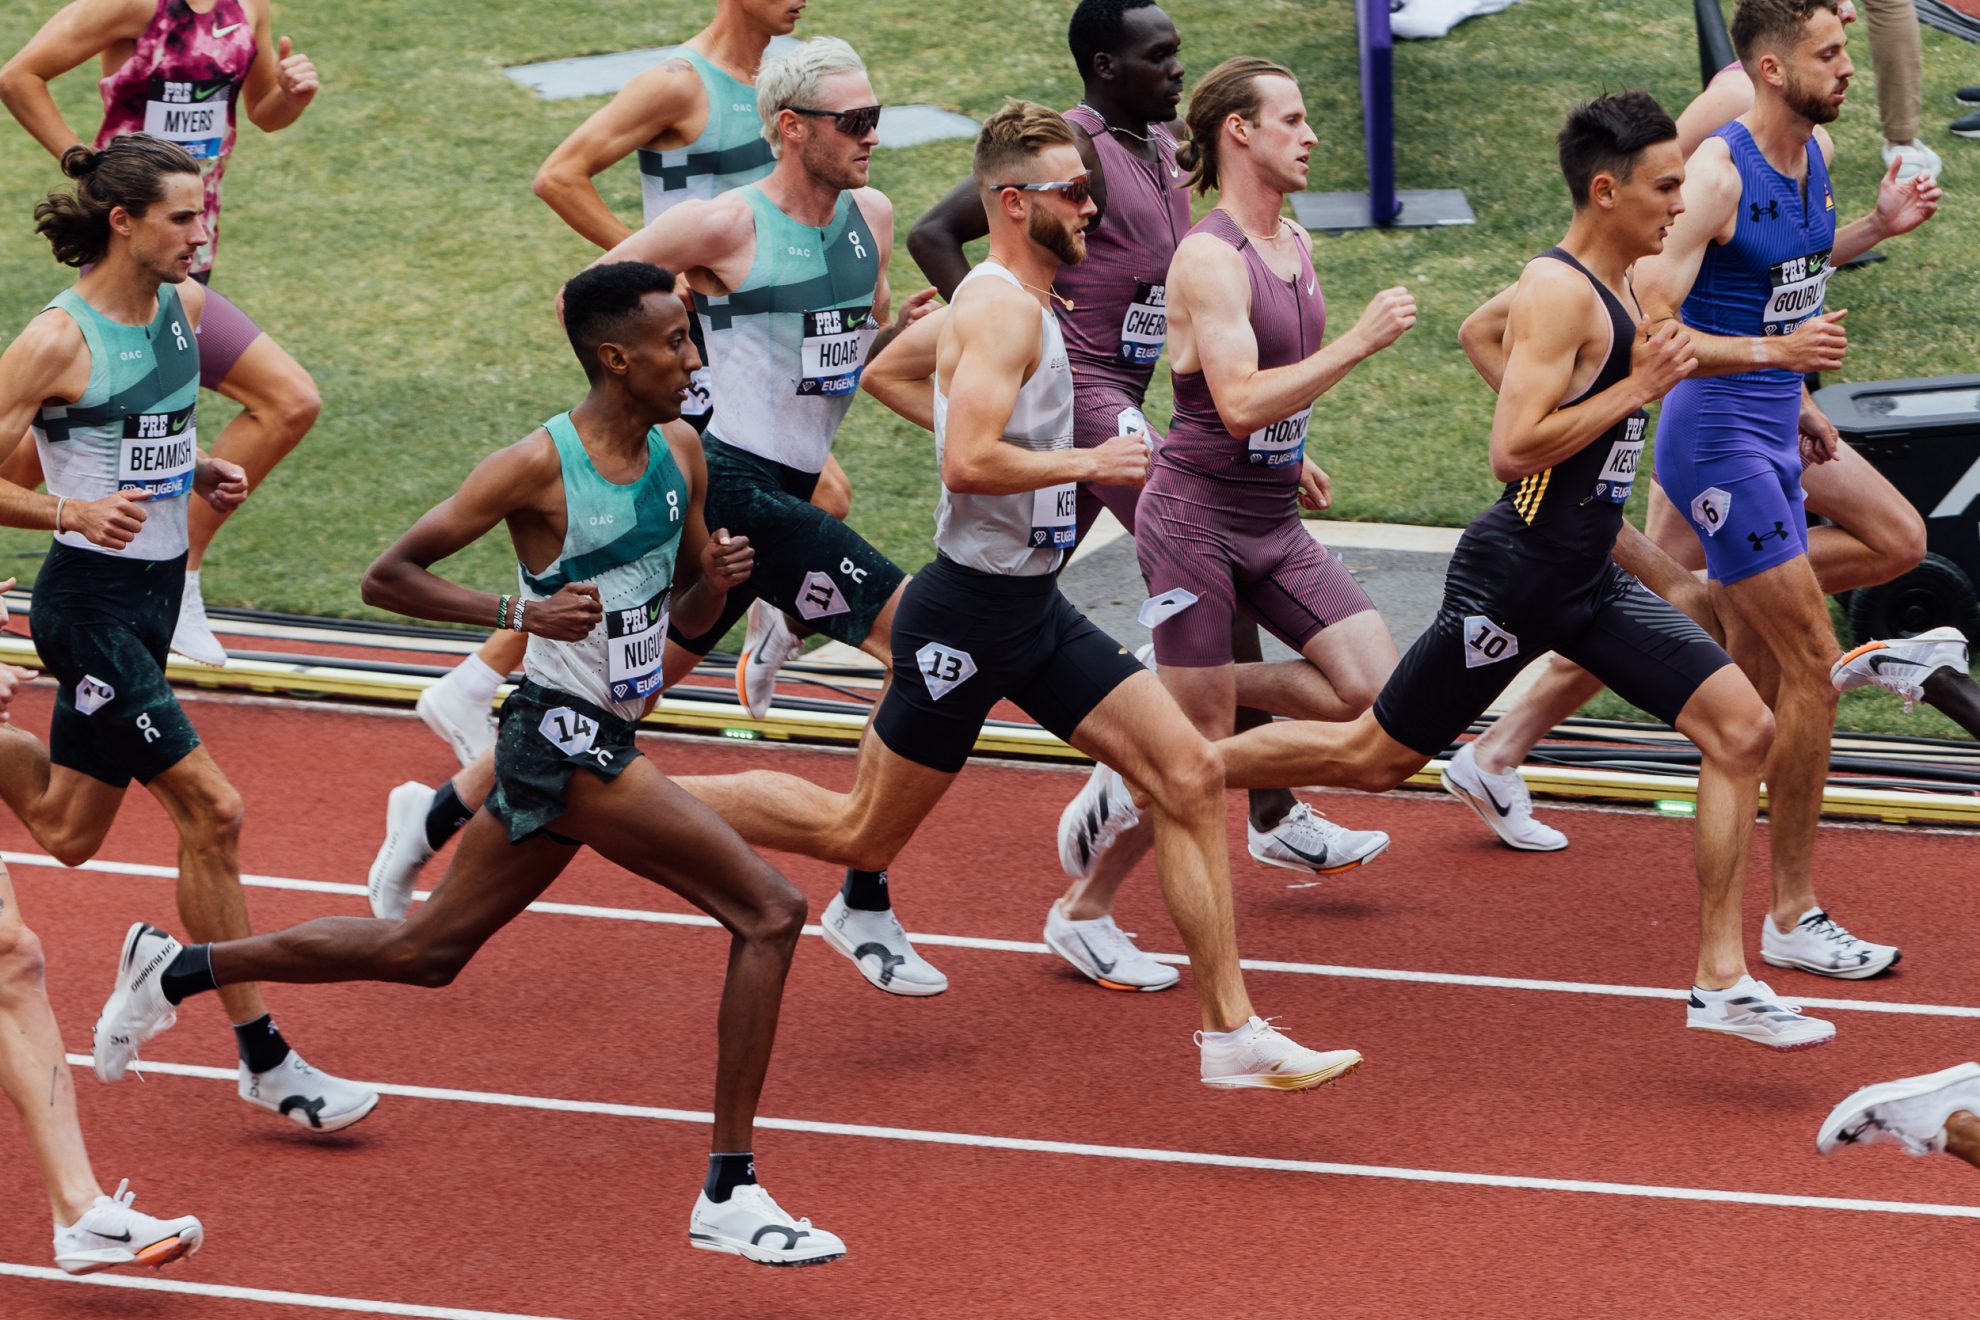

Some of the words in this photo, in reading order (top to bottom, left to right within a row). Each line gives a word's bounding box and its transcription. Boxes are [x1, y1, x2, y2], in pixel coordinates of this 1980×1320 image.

[164, 110, 214, 132] MYERS
[788, 246, 811, 257] OAC
[1782, 257, 1807, 284] PRE
[1145, 285, 1166, 305] PR
[815, 311, 842, 335] PRE
[120, 350, 143, 361] OAC
[138, 414, 168, 438] PRE
[1624, 418, 1645, 441] PRE
[130, 438, 192, 472] BEAMISH
[589, 514, 614, 526] OAC
[1702, 499, 1719, 524] 6
[621, 605, 648, 635] PRE
[1469, 625, 1508, 659] 10
[927, 650, 963, 682] 13
[553, 712, 591, 744] 14
